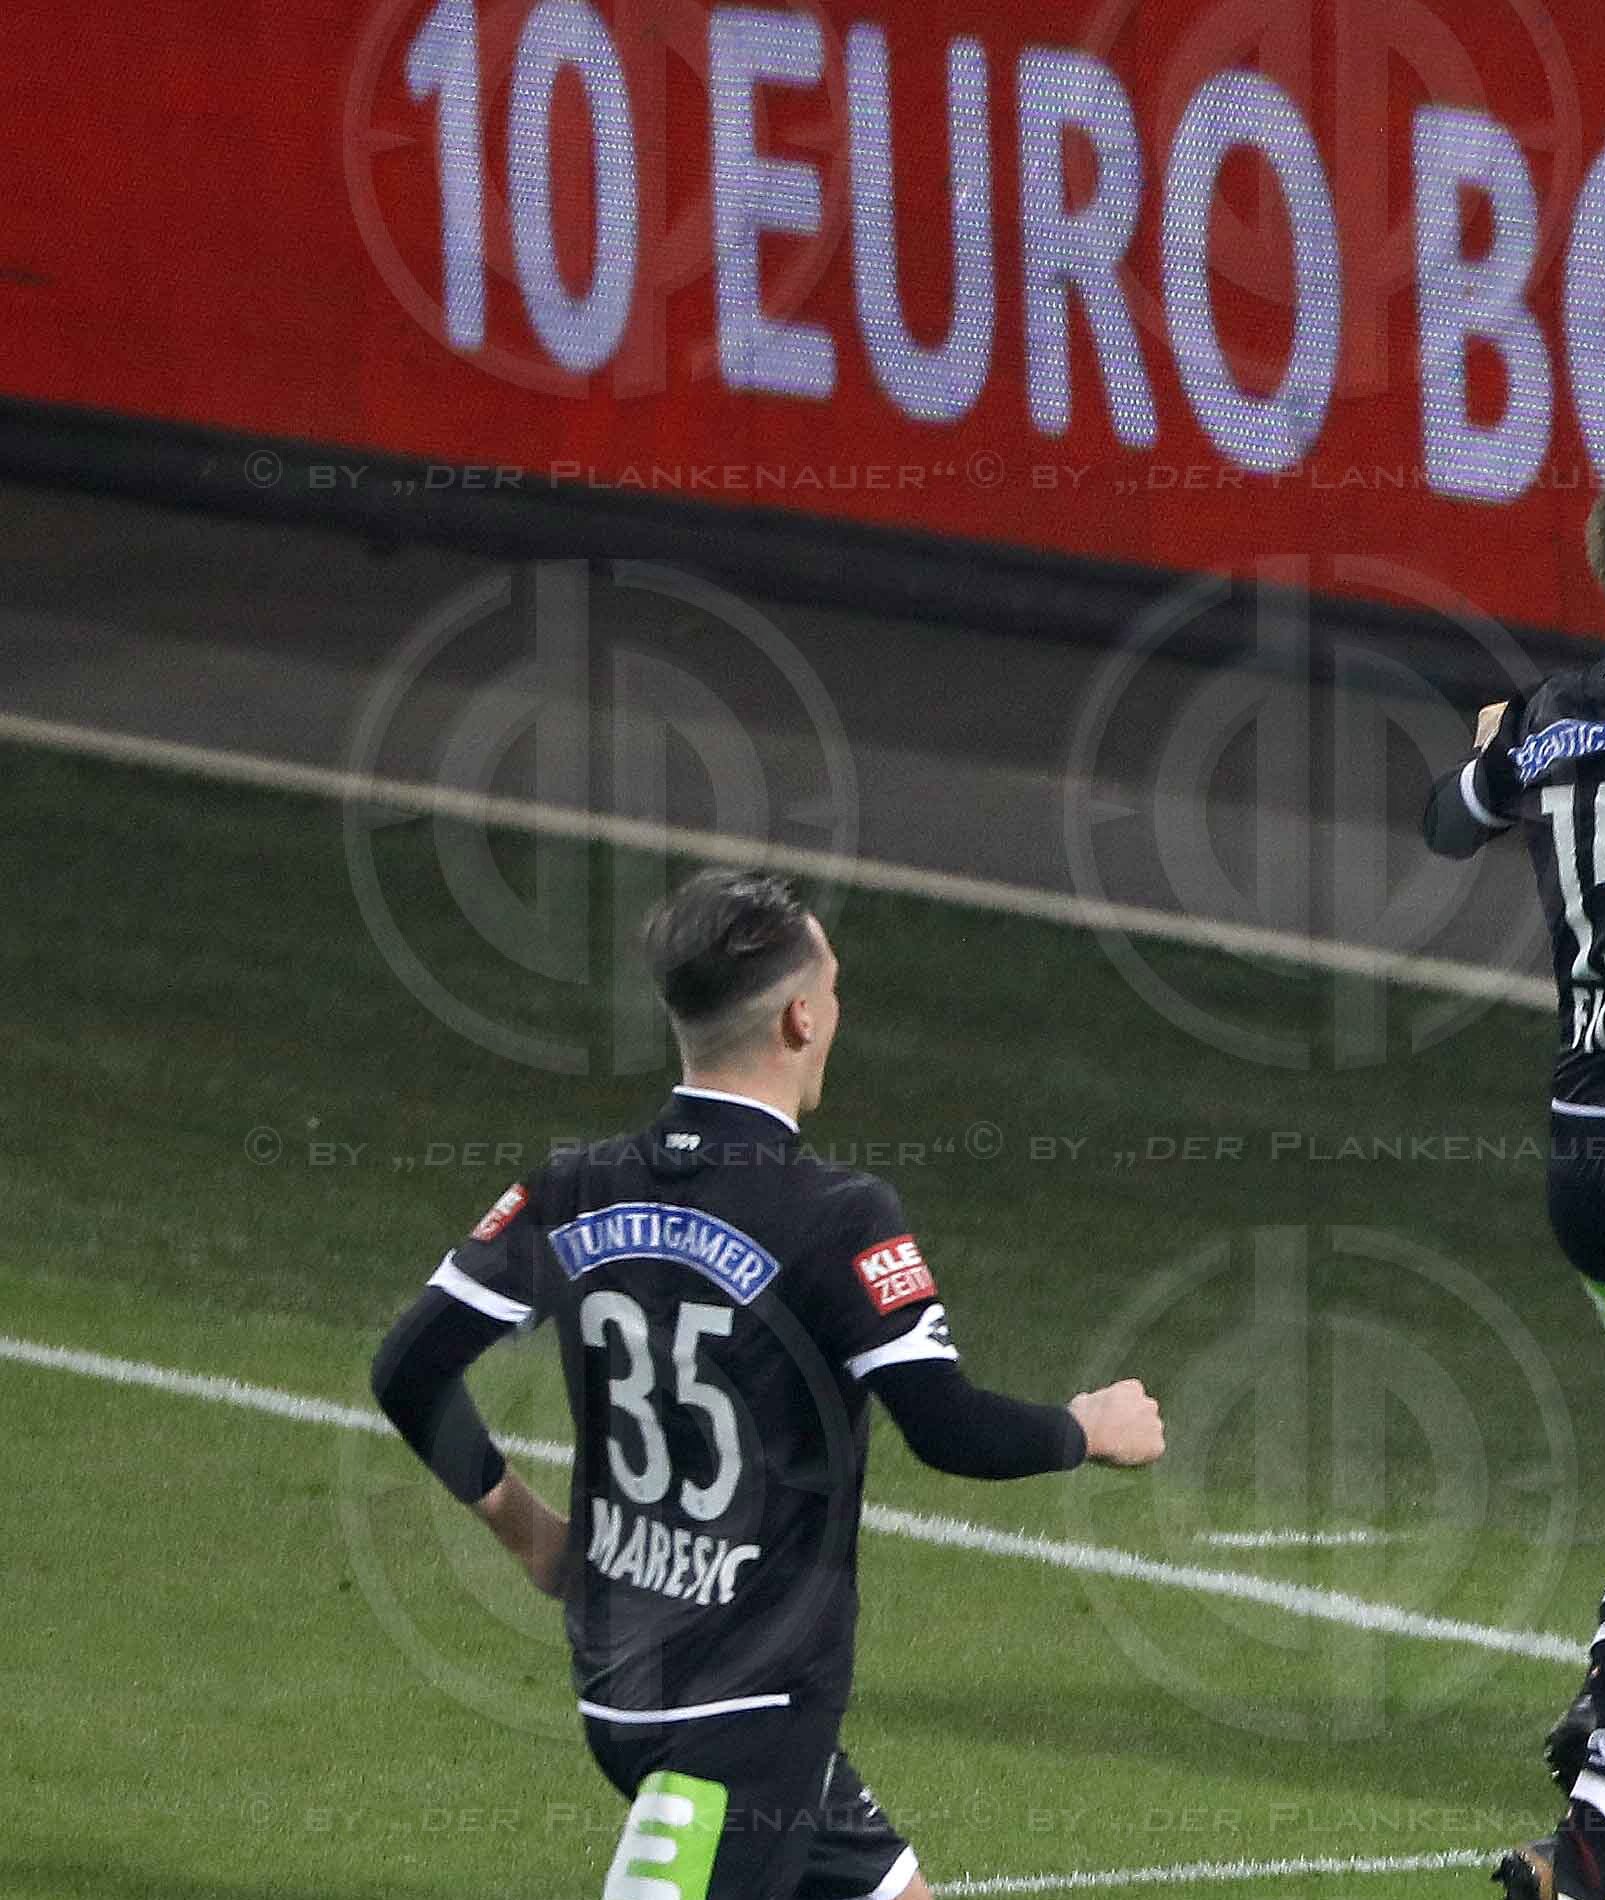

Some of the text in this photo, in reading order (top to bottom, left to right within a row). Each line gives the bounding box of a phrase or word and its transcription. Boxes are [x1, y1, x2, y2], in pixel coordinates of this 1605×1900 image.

[407, 0, 638, 375] 10
[711, 7, 1341, 478] EURO
[580, 1290, 742, 1521] 35
[587, 1497, 761, 1605] MARESIC
